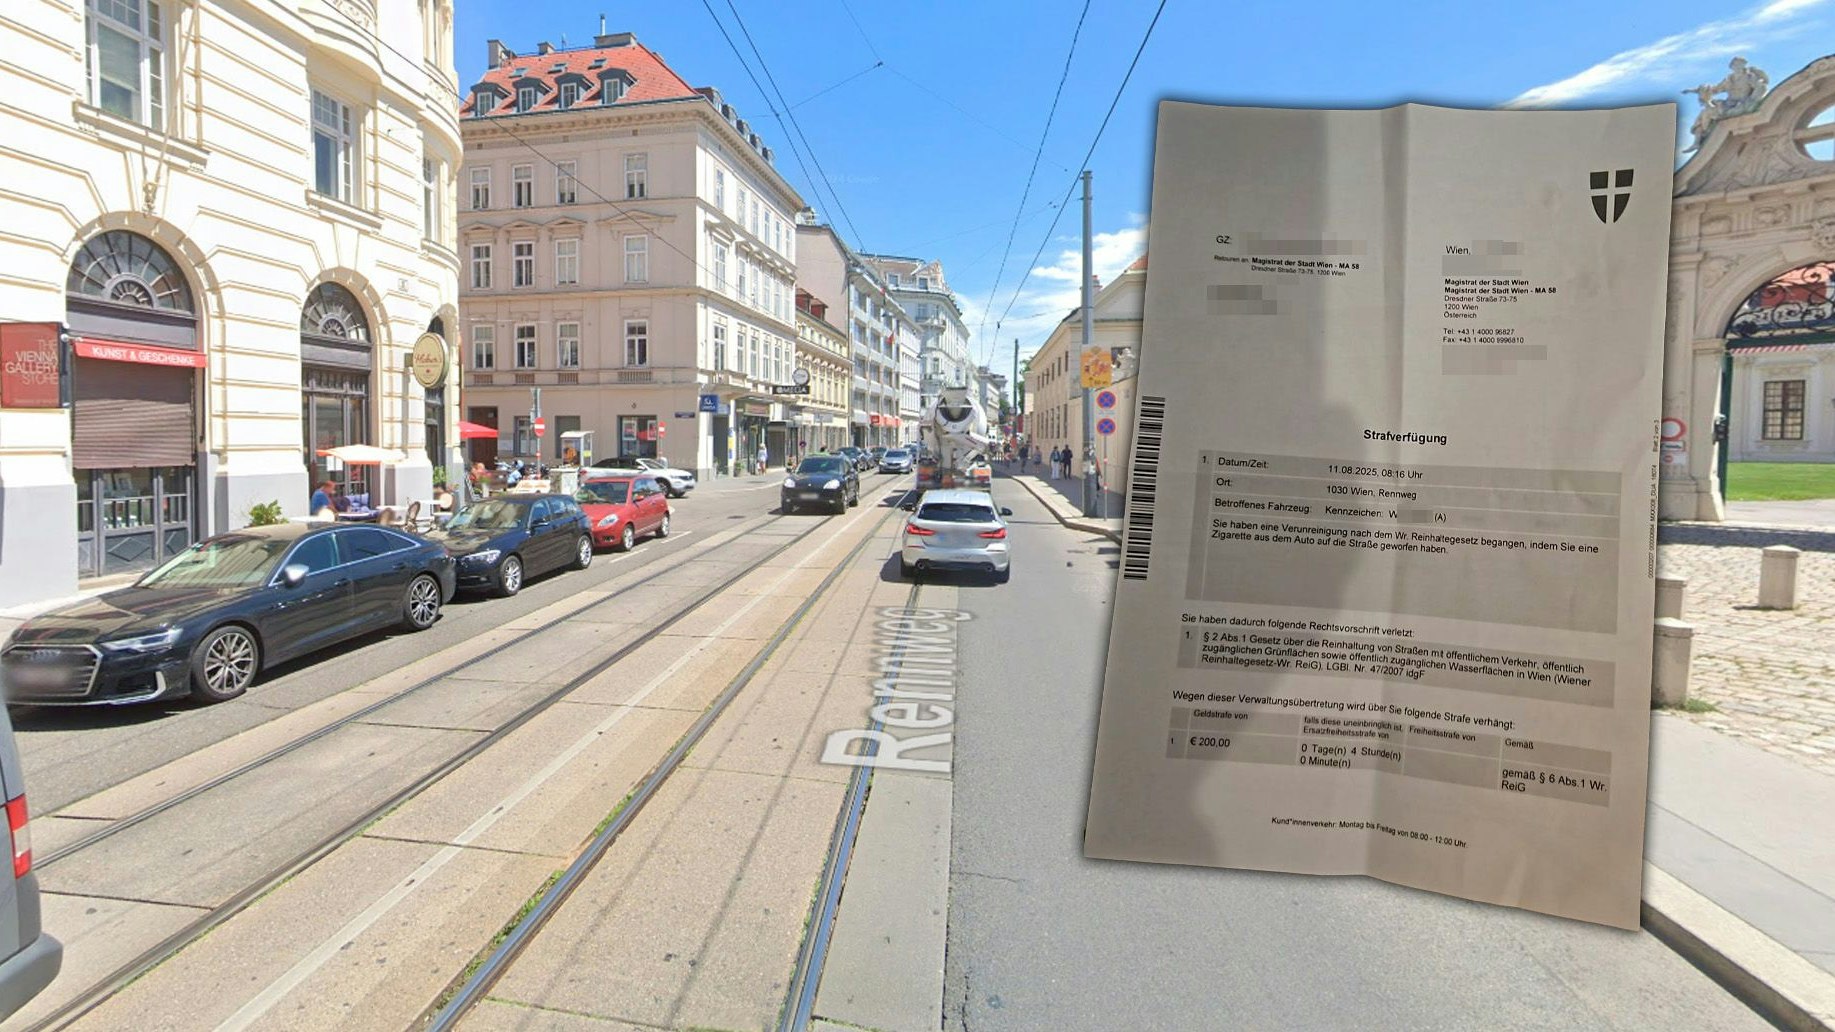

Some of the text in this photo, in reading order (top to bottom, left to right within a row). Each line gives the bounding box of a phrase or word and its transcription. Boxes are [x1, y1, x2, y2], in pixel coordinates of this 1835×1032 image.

[1446, 245, 1471, 255] Wien,
[1251, 265, 1276, 273] Dresdner
[1252, 257, 1283, 266] Magistrat
[1298, 260, 1315, 268] Stadt
[1317, 261, 1333, 269] Wien
[1444, 279, 1477, 287] Magistrat
[1444, 287, 1477, 295] Magistrat
[1476, 295, 1497, 303] Straße
[1443, 310, 1477, 319] Österreich
[38, 340, 58, 350] THE
[15, 351, 58, 363] VIENNA
[92, 347, 195, 365] KUNST & GESCHENKE
[5, 362, 58, 374] GALLERY
[22, 373, 59, 385] STORE
[1363, 429, 1447, 445] Strafverfügung
[1218, 457, 1269, 469] Datum/Zeit:
[1328, 465, 1378, 477] 11.08.2025,
[1381, 469, 1405, 478] 08:16
[1407, 471, 1423, 479] Uhr
[1216, 478, 1417, 500] Ort: 1030 Wien, Rennweg
[1214, 498, 1447, 523] Betroffenes Fahrzeug: Kennzeichen: W (A)
[1211, 530, 1252, 541] Zigarette
[1254, 534, 1270, 542] aus
[1272, 534, 1292, 543] dem
[1294, 535, 1315, 545] Auto
[1317, 537, 1331, 546] auf
[1332, 538, 1347, 547] die
[1349, 539, 1378, 549] Straße
[1380, 541, 1418, 553] geworfen
[1213, 519, 1599, 553] Sie haben eine Verunreinigung nach dem Wr. Reinhaltegesetz begangen, indem Sie eine
[1181, 614, 1415, 637] Sie haben dadurch folgende Rechtsvorschrift verletzt:
[1203, 632, 1584, 674] § 2 Gesetz über die Reinhaltung von Straßen mit öffentlichem Verkehr, öffentlich
[1202, 644, 1592, 687] zugänglichen Grünflächen sowie öffentlich zugänglichen Wasserflächen in Wien (Wiener
[1370, 664, 1403, 677] 47/2007
[1406, 669, 1425, 679] idgF
[1172, 691, 1516, 730] Wegen dieser Verwaltungsübertretung wird über Sie folgende Strafe verhängt:
[1193, 709, 1248, 720] Geldstrafe von
[1304, 716, 1392, 730] falls diese uneinbringlich
[1303, 726, 1390, 739] Ersatzfreiheitsstrafe von
[1409, 725, 1476, 741] Freiheitsstrafe von
[1190, 737, 1231, 748] € 200,00
[1505, 738, 1534, 750] Gemäß
[1301, 744, 1402, 761] 0 Tage(n) 4 Stunde(n)
[1300, 756, 1351, 768] 0 Minute(n)
[1501, 780, 1526, 792] ReiG
[1502, 768, 1536, 781] gemäß
[1539, 772, 1546, 784] §
[1549, 774, 1555, 783] 6
[1590, 780, 1608, 792] Wr.
[1339, 821, 1364, 830] Montag
[1366, 822, 1375, 830] bis
[1376, 824, 1396, 835] Freitag
